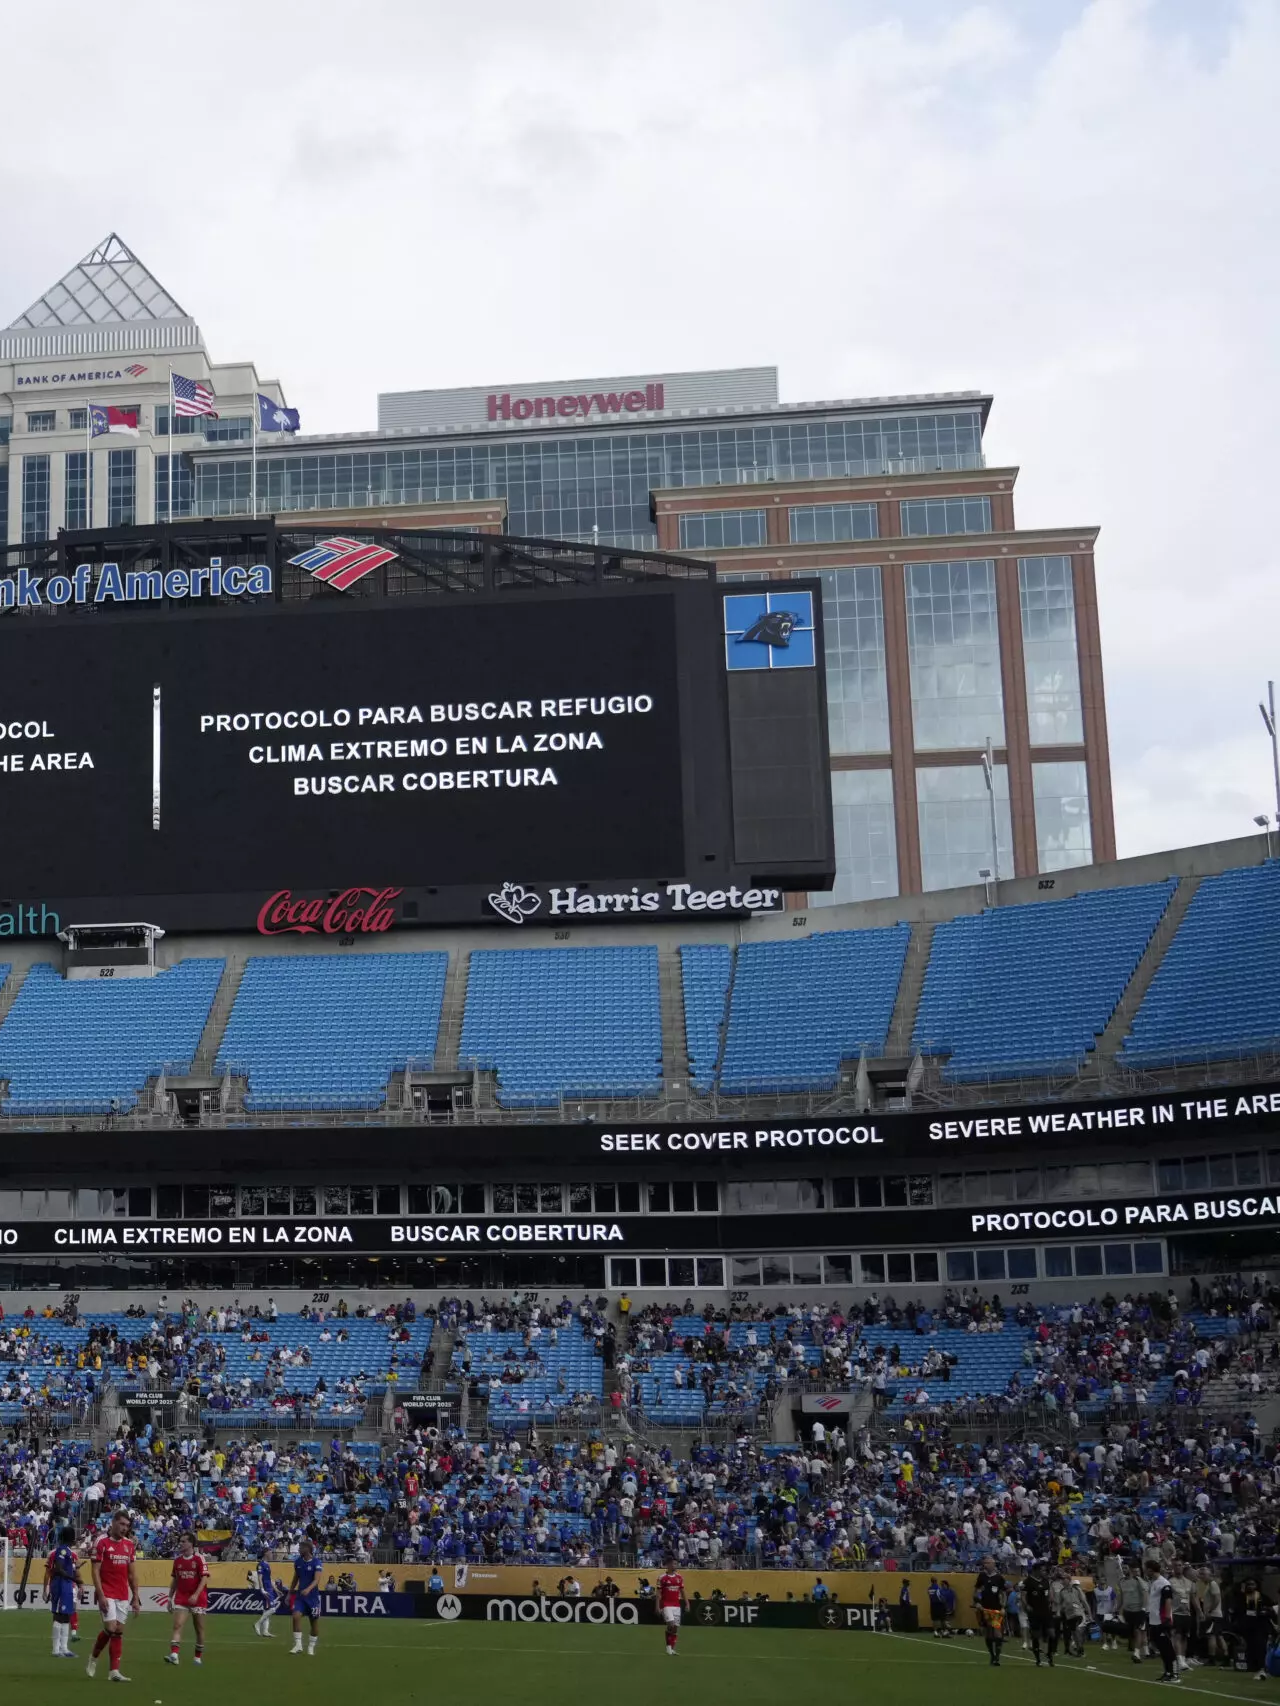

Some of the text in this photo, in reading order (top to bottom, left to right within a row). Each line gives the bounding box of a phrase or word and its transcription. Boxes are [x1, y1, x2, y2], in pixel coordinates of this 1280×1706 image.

[17, 370, 122, 386] BANK OF AMERICA
[486, 383, 665, 421] Honeywell
[46, 562, 91, 605] of
[94, 557, 273, 602] America
[200, 694, 653, 733] PROTOCOLO PARA BUSCAR REFUGIO
[248, 731, 604, 764] CLIMA EXTREMO EN LA ZONA
[29, 751, 95, 771] AREA
[293, 767, 558, 796] BUSCAR COBERTURA
[1038, 880, 1055, 890] 532
[548, 883, 779, 915] Harris Teeter
[792, 917, 807, 927] 531
[99, 968, 115, 977] 528
[929, 1093, 1280, 1140] SEVERE WEATHER IN THE ARE
[600, 1126, 884, 1151] SEEK COVER PROTOCOL
[971, 1195, 1280, 1232] PROTOCOLO PARA BUSCA
[54, 1226, 353, 1245] CLIMA EXTREMO EN LA ZONA
[390, 1224, 624, 1242] BUSCAR COBERTURA
[312, 1293, 329, 1303] 230
[731, 1292, 749, 1302] 232
[319, 1594, 387, 1615] LTRA
[486, 1595, 639, 1625] motorola
[723, 1604, 760, 1624] PIF
[846, 1607, 880, 1632] PIF
